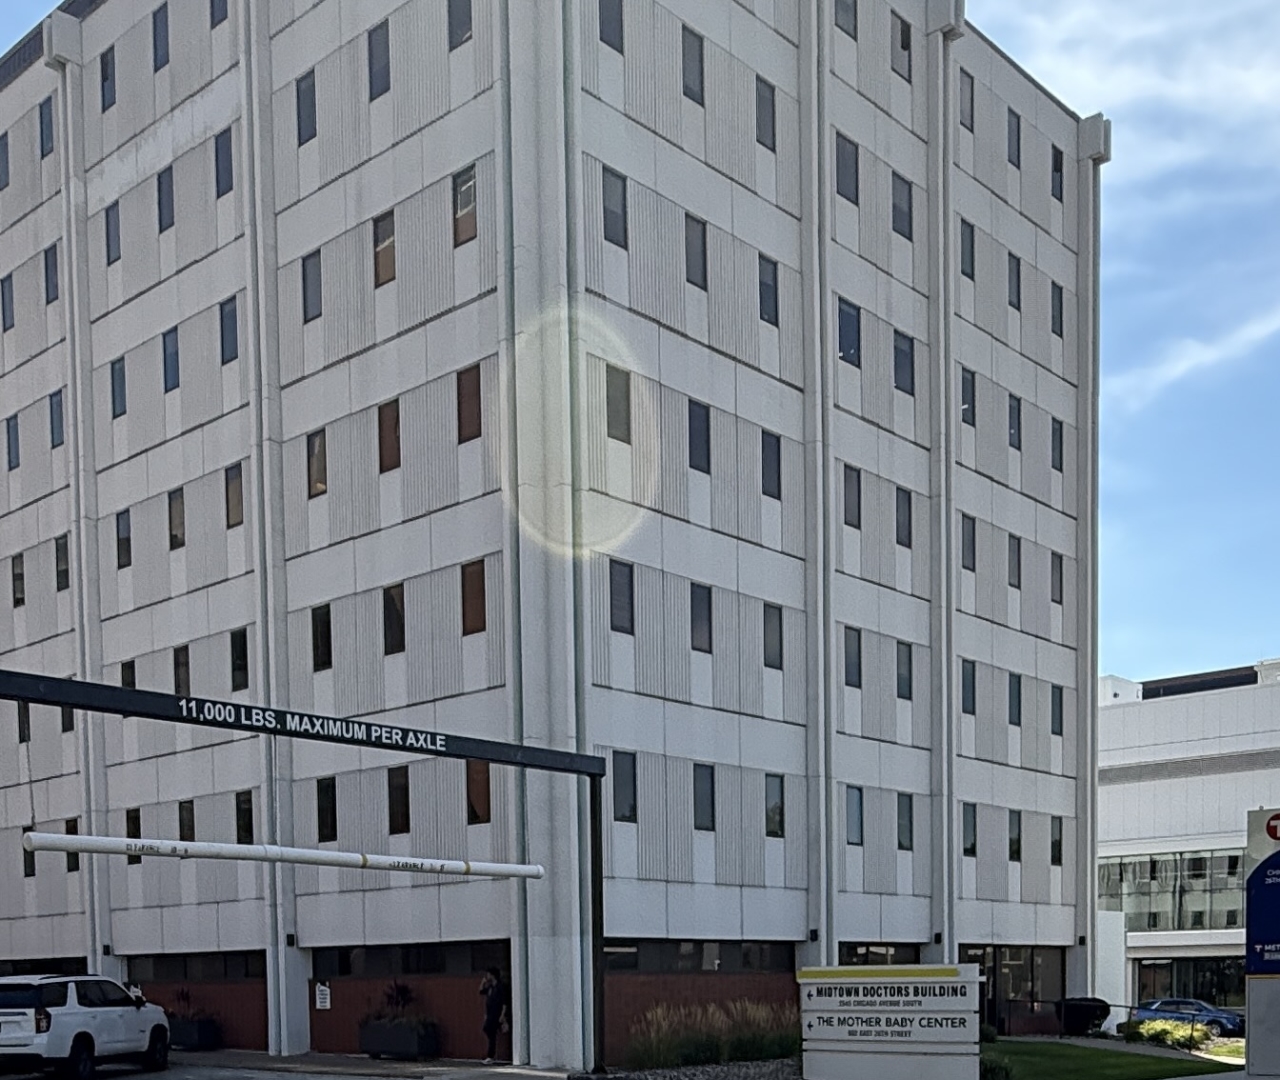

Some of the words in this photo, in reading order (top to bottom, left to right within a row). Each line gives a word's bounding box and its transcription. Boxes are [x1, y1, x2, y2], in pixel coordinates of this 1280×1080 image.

[178, 699, 236, 722] 11,000
[240, 707, 281, 729] LBS.
[286, 714, 367, 741] MAXIMUM
[371, 726, 403, 746] PER
[405, 731, 447, 751] AXLE
[816, 986, 859, 998] MIDTOWN
[862, 986, 910, 998] DOCTORS
[913, 985, 967, 998] BUILDING
[817, 1016, 834, 1027] THE
[837, 1017, 882, 1027] MOTHER
[885, 1017, 915, 1028] BABY
[918, 1017, 967, 1028] CENTER
